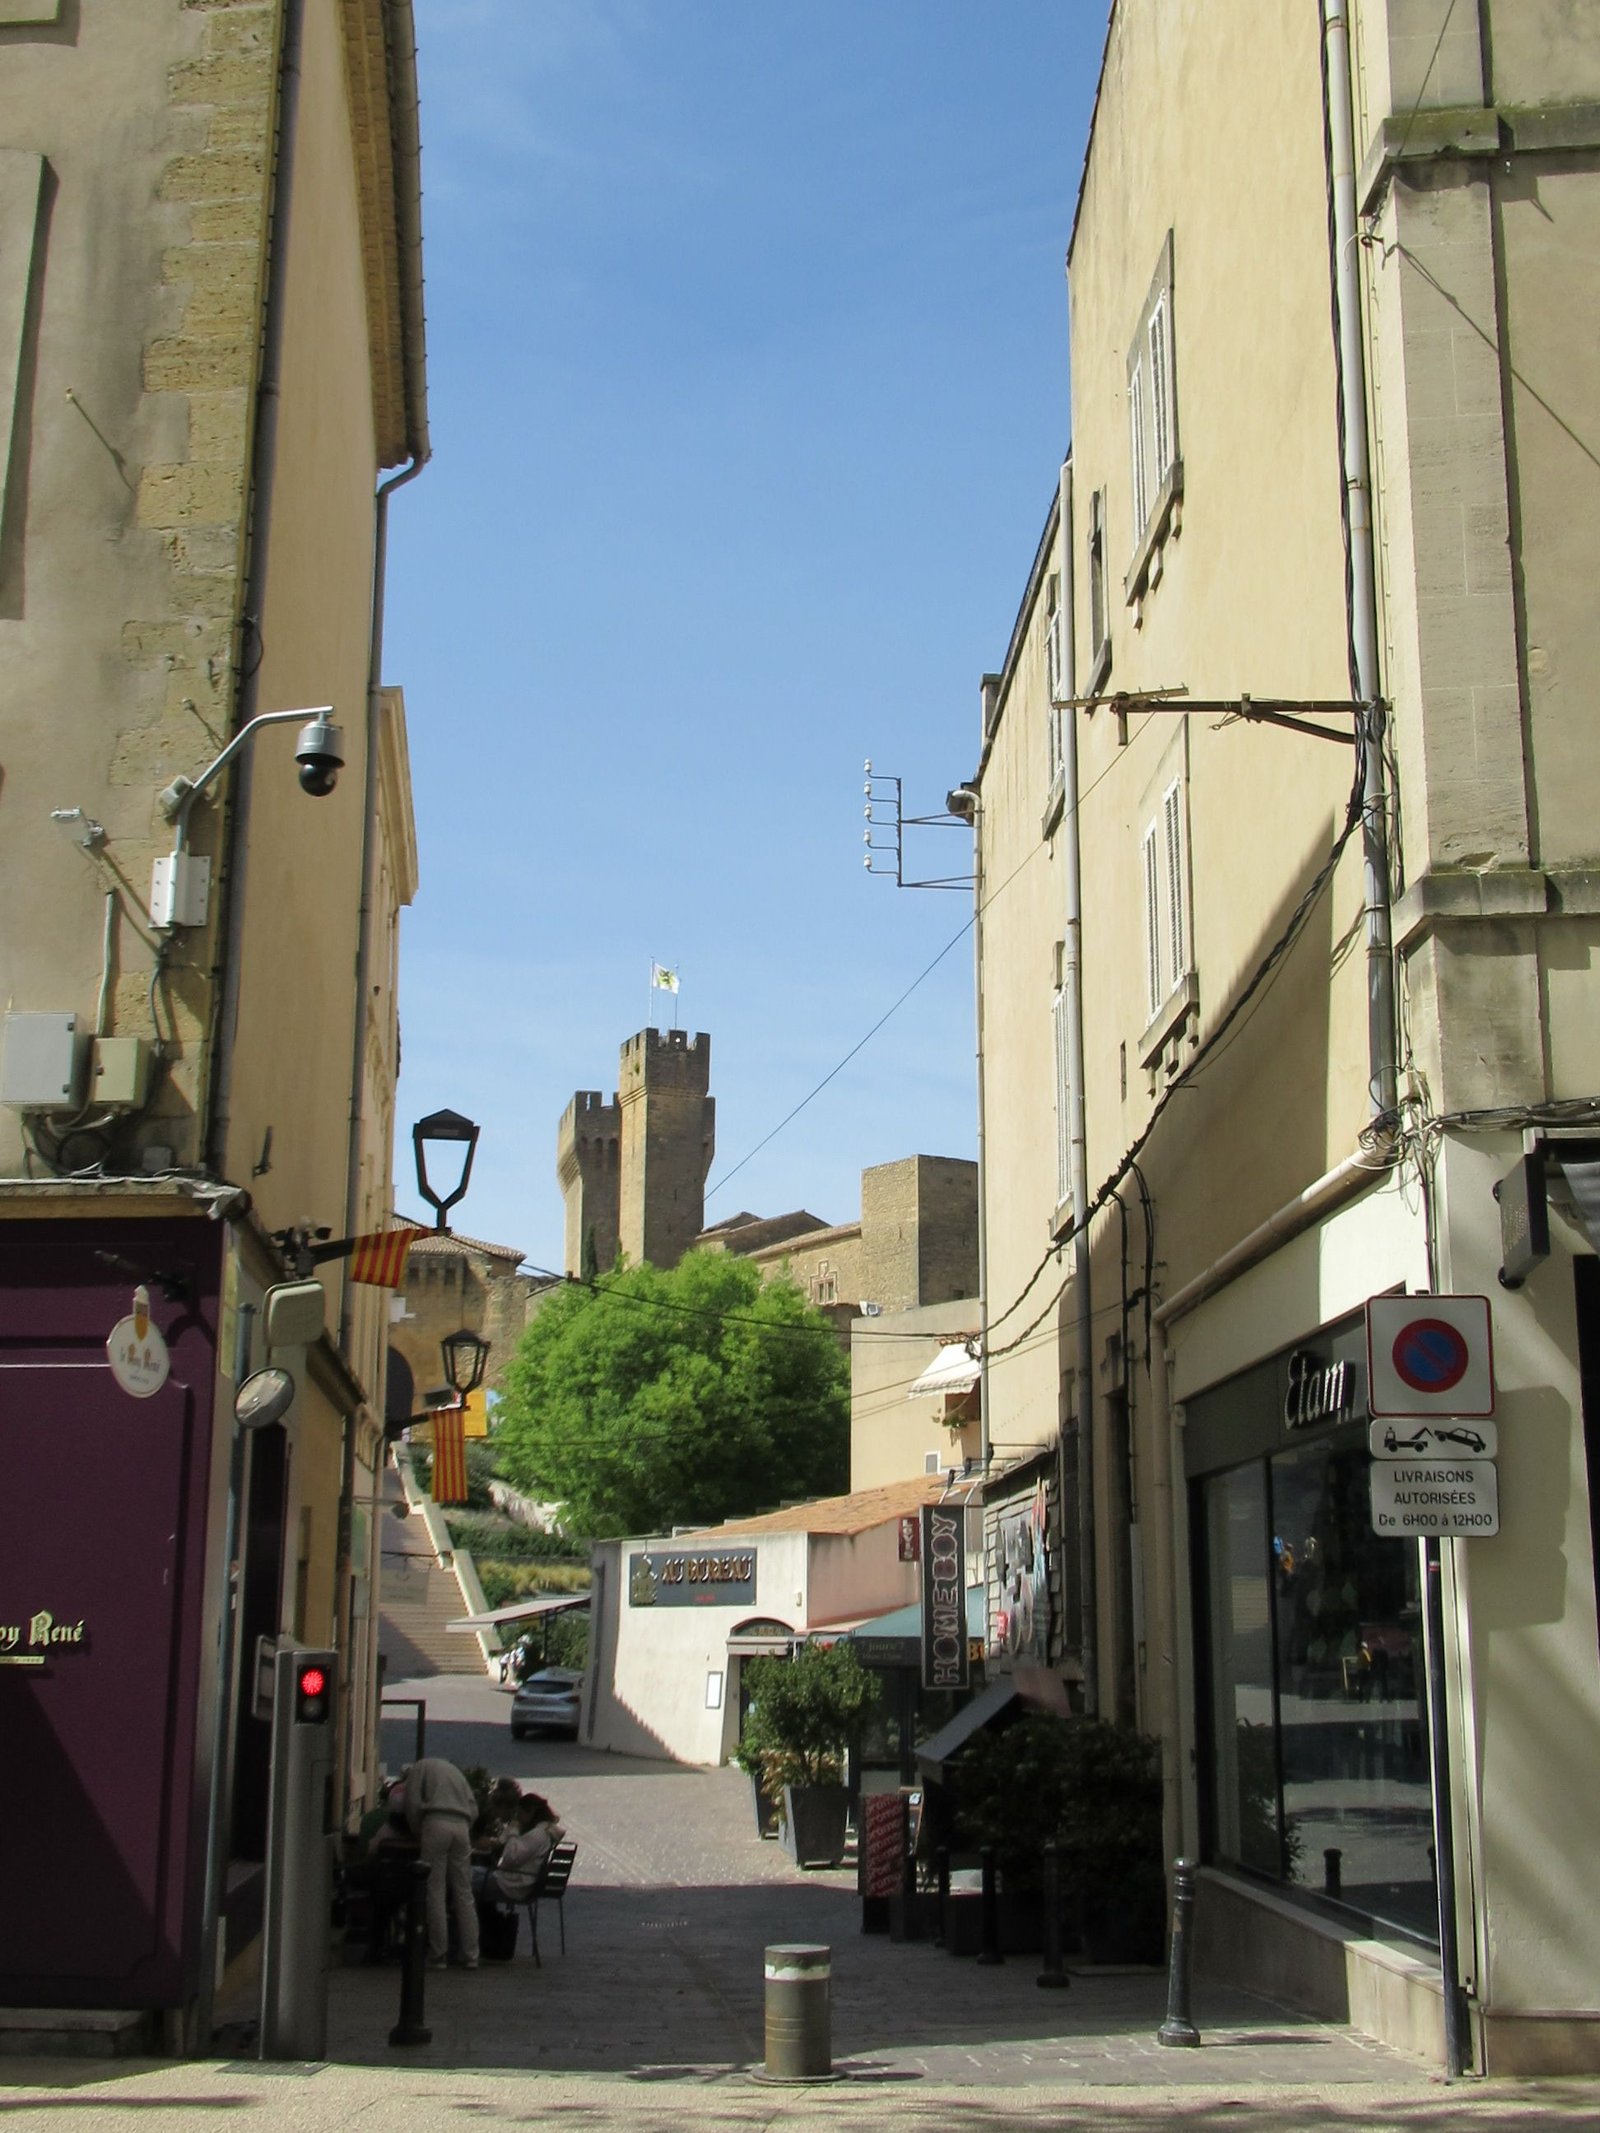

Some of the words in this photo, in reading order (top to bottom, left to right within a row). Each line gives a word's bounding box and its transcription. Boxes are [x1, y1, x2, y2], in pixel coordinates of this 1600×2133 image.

[1394, 1471, 1474, 1483] LIVRAISONS
[1394, 1489, 1476, 1505] AUTORISÉES
[1379, 1514, 1396, 1526] De
[1403, 1514, 1438, 1526] 6H00
[1441, 1514, 1449, 1526] à
[1453, 1514, 1493, 1526] 12H00
[662, 1558, 685, 1582] AU
[687, 1556, 752, 1582] BUREAU
[28, 1610, 85, 1646] René
